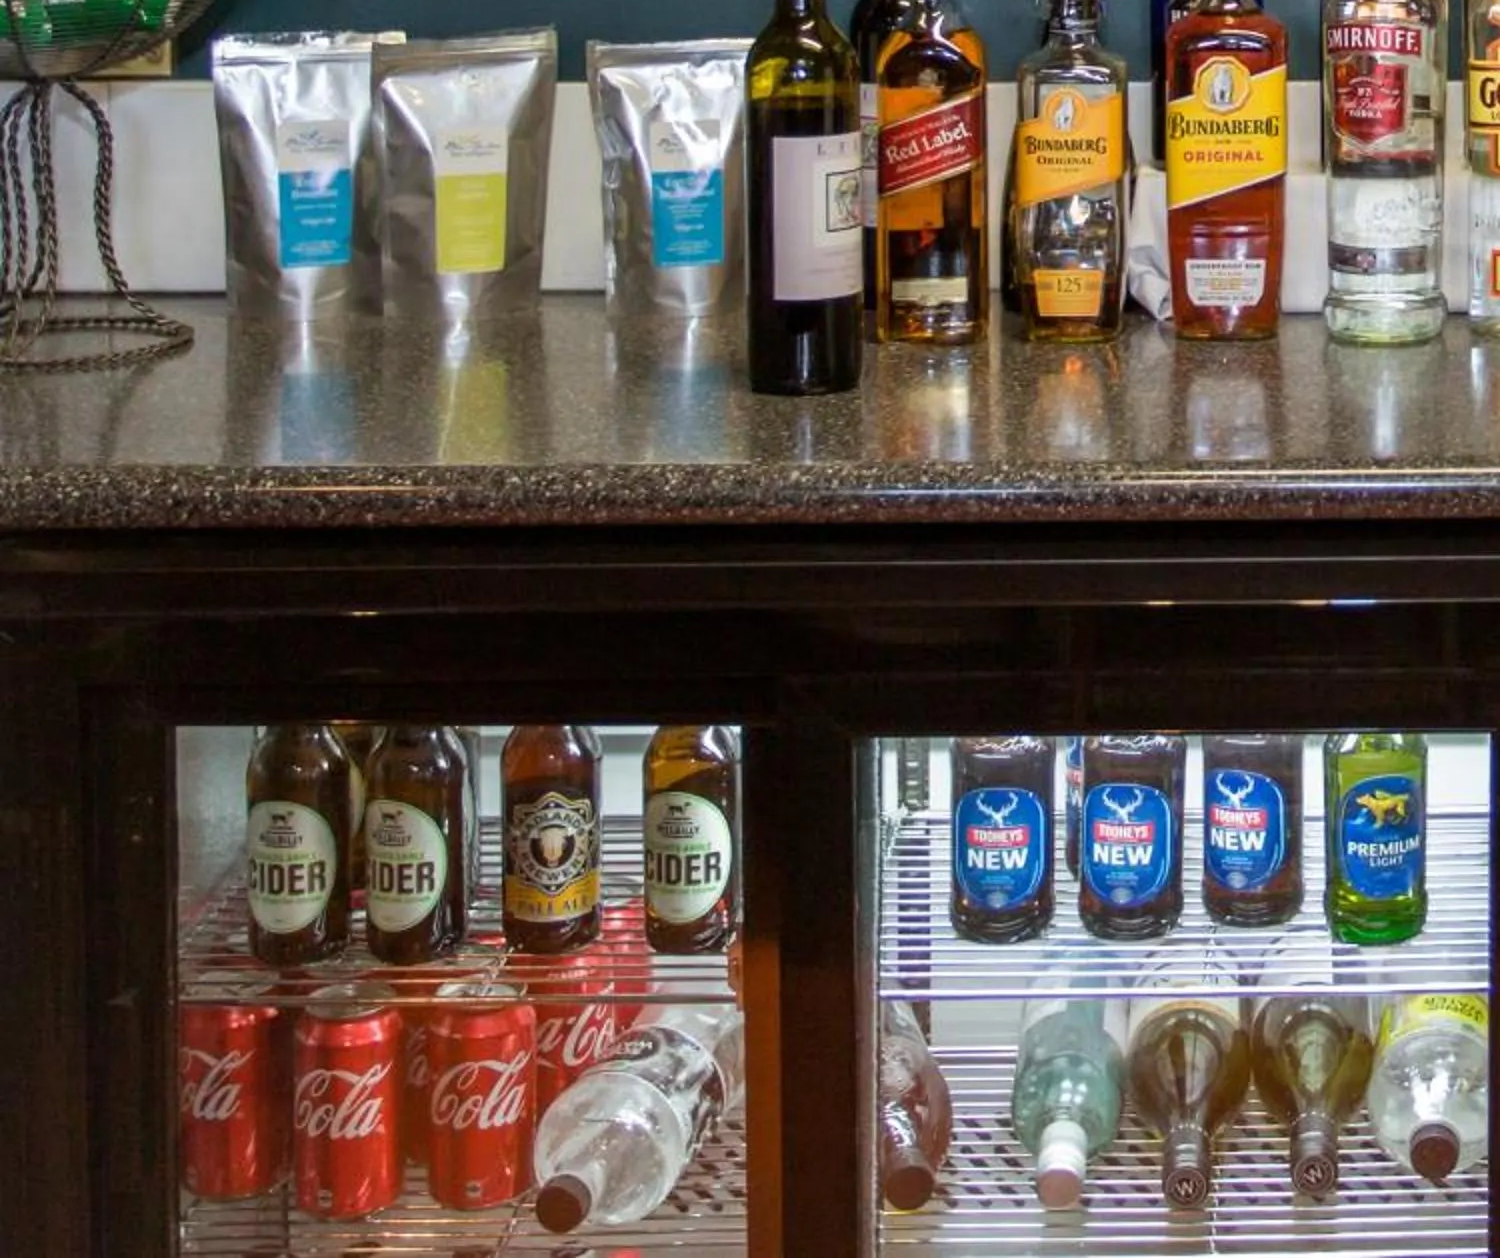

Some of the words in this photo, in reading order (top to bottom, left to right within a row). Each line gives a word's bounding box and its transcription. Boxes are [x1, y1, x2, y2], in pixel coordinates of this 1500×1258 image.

[1168, 111, 1280, 140] BUNDABERG
[885, 139, 921, 164] Red
[1025, 135, 1107, 155] BUNDABERG
[1036, 154, 1093, 166] ORIGINAL
[1184, 150, 1264, 162] ORIGINAL
[1055, 277, 1081, 292] 125
[1214, 809, 1262, 824] TOOHEYS
[972, 830, 1024, 842] TOOHEYS
[1098, 824, 1149, 839] TOOHEYS
[1210, 828, 1266, 851] NEW
[1092, 842, 1153, 866] NEW
[1347, 835, 1420, 856] PREMIUM
[967, 848, 1028, 870] NEW
[1369, 857, 1404, 867] LIGHT
[369, 860, 436, 895] IDER
[430, 1046, 533, 1131] Cola
[293, 1060, 393, 1140] Cola
